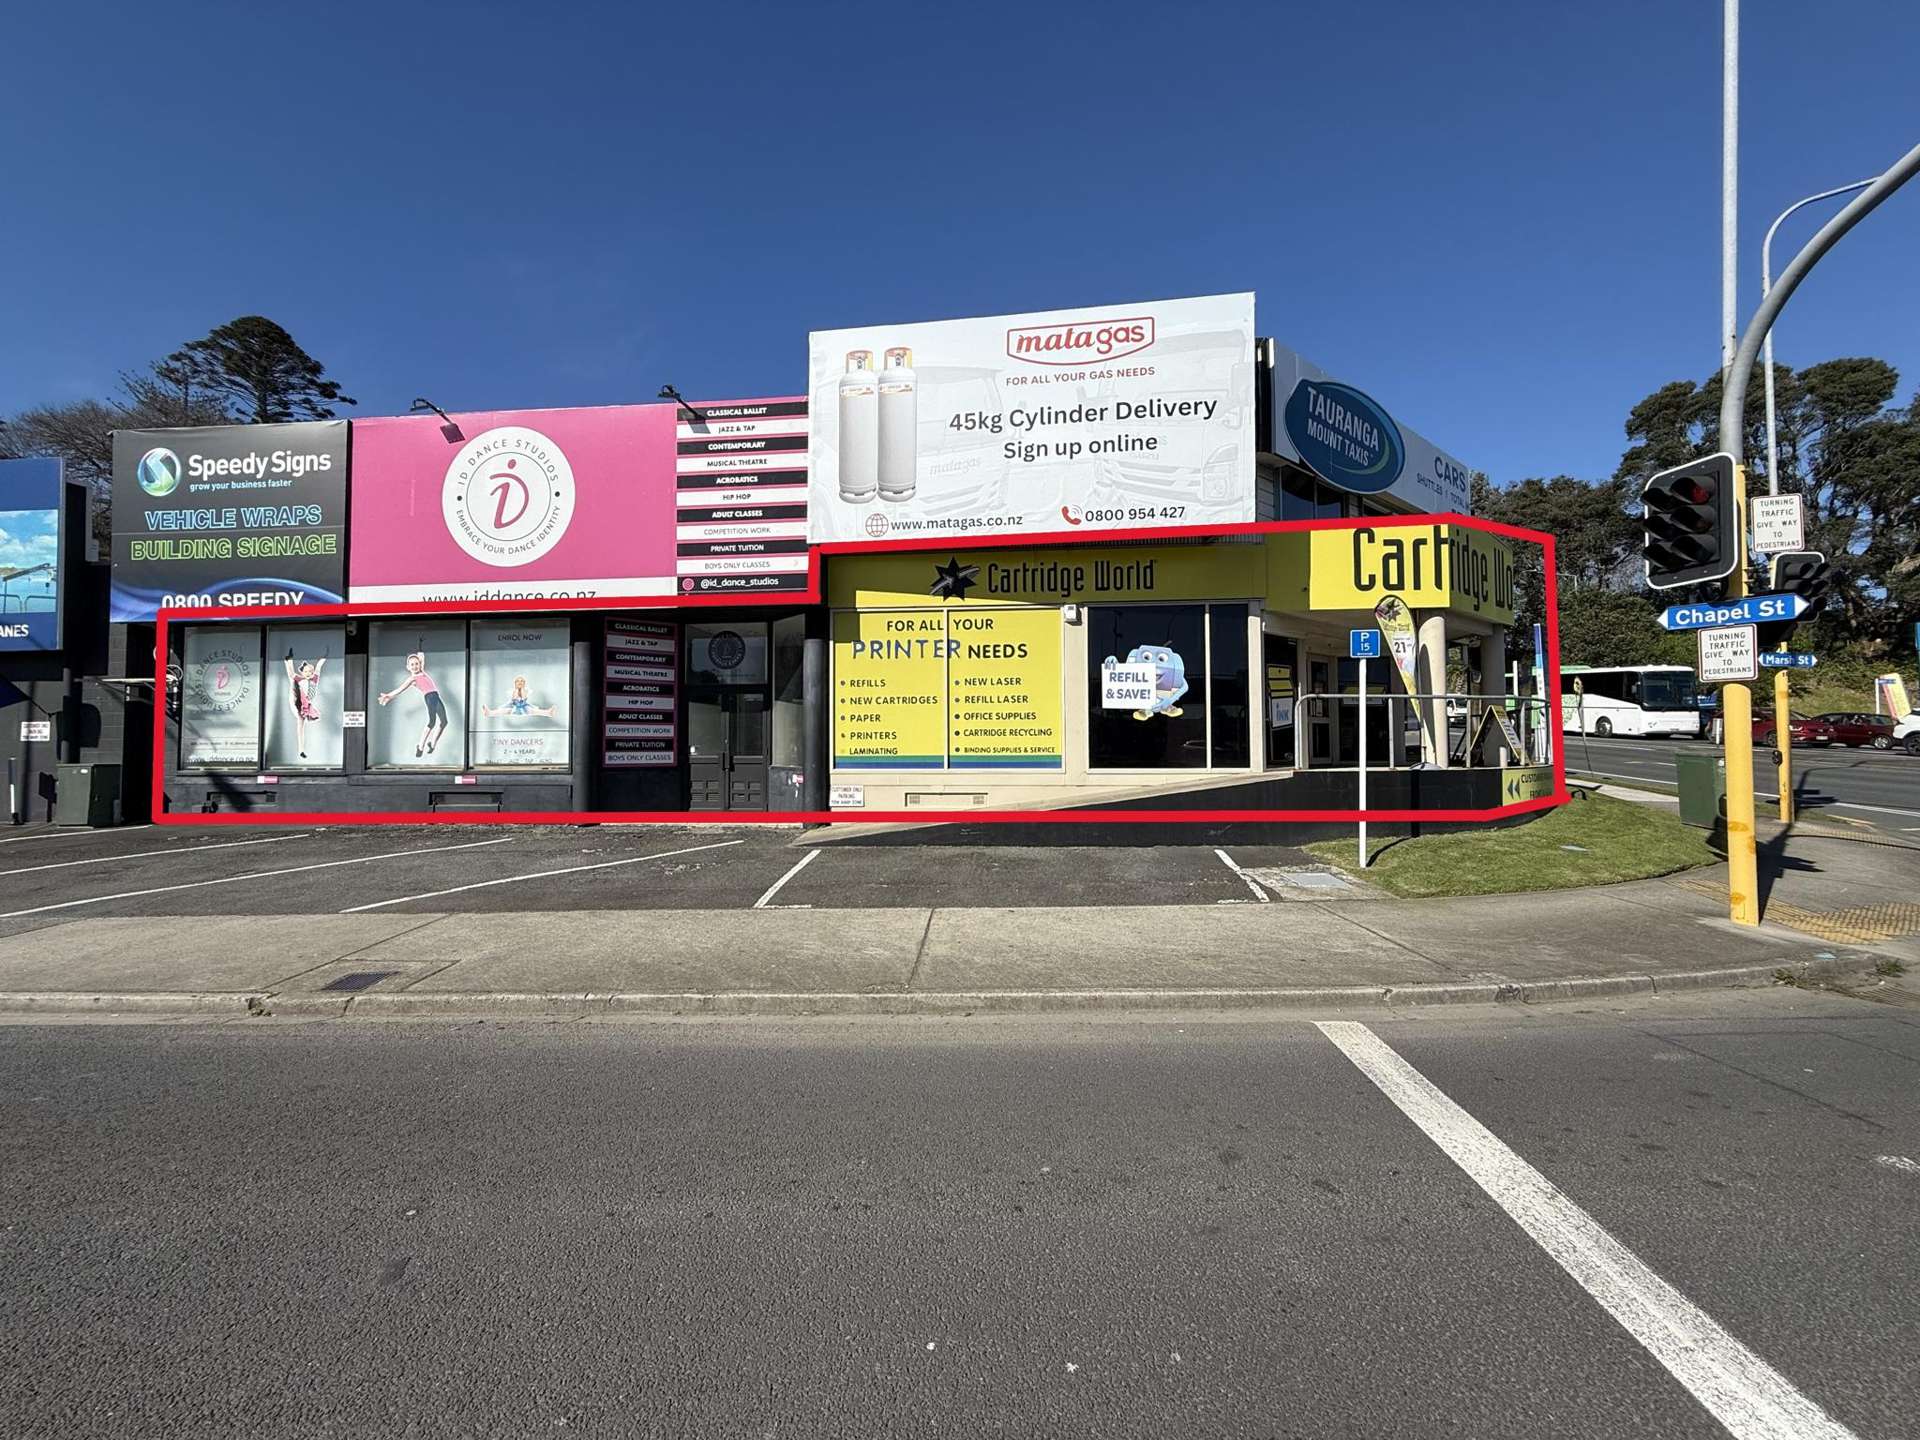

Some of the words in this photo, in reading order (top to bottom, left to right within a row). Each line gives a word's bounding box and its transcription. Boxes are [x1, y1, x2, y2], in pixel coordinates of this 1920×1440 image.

[1016, 323, 1145, 355] matagas
[1005, 376, 1026, 387] FOR
[1029, 375, 1051, 385] ALL
[1054, 373, 1086, 383] YOUR
[1089, 370, 1113, 381] GAS
[1116, 367, 1156, 378] NEEDS
[707, 409, 741, 417] CLASSICAL
[743, 407, 767, 415] BALLET
[949, 411, 1003, 434] 45kg
[1009, 403, 1108, 432] Cylinder
[1116, 397, 1218, 421] Delivery
[1307, 387, 1379, 451] TAURANGA
[718, 425, 735, 434] JAZZ
[708, 442, 765, 450] CONTEMPORARY
[1307, 418, 1343, 450] MOUNT
[1344, 438, 1369, 467] TAXIS
[1003, 441, 1049, 465] Sign
[1055, 442, 1082, 461] up
[1089, 434, 1158, 456] online
[188, 452, 268, 479] Speedy
[272, 449, 332, 476] Signs
[458, 471, 468, 485] ID
[468, 439, 507, 466] DANCE
[515, 439, 559, 481] STUDIOS
[1434, 456, 1466, 492] CARS
[716, 476, 758, 484] ACROBATICS
[190, 484, 210, 492] grow
[212, 483, 229, 491] your
[230, 481, 267, 489] business
[268, 479, 292, 488] faster
[1760, 498, 1794, 507] TURNING
[145, 508, 236, 530] VEHICLE
[241, 504, 322, 527] WRAPS
[1085, 509, 1124, 523] 0800
[1128, 507, 1156, 521] 954
[1160, 506, 1185, 519] 427
[1761, 508, 1794, 517] TRAFFIC
[890, 514, 1024, 532] www.matagas.co.nz
[1756, 520, 1773, 529] GIVE
[1781, 519, 1798, 527] WAY
[456, 510, 481, 545] EMBRACE
[483, 542, 505, 554] YOUR
[508, 541, 536, 554] DANCE
[538, 506, 561, 542] IDENTITY
[131, 537, 232, 561] BUILDING
[237, 534, 337, 557] SIGNAGE
[1756, 540, 1801, 549] PEDESTRIANS
[1353, 525, 1489, 612] Cartridge
[988, 562, 1084, 597] Cartridge
[1094, 559, 1155, 592] World
[700, 578, 779, 589] @id_dance_studios
[1675, 602, 1751, 626] Chapel
[1758, 600, 1786, 617] St
[887, 620, 914, 632] FOR
[919, 619, 944, 631] ALL
[953, 619, 994, 631] YOUR
[523, 633, 543, 641] NOW
[1360, 632, 1370, 642] P
[1708, 632, 1746, 641] TURNING
[852, 639, 961, 661] PRINTER
[968, 644, 1028, 659] NEEDS
[1360, 642, 1370, 651] 15
[1394, 641, 1406, 653] 21
[1709, 641, 1745, 650] TRAFFIC
[615, 653, 666, 663] CONTEMPORARY
[1704, 651, 1723, 659] GIVE
[1732, 649, 1750, 657] WAY
[1766, 655, 1795, 665] Marsh
[1798, 655, 1809, 664] St
[614, 669, 642, 677] MUSICAL
[1704, 666, 1752, 675] PEDESTRIANS
[964, 677, 987, 686] NEW
[990, 677, 1022, 686] LASER
[1109, 671, 1149, 682] REFILL
[850, 679, 886, 687] REFILLS
[623, 684, 660, 693] ACROBATICS
[964, 695, 994, 704] REFILL
[997, 695, 1028, 703] LASER
[1106, 689, 1115, 700] &
[1117, 689, 1150, 700] SAVE!
[850, 696, 873, 705] NEW
[875, 695, 938, 705] CARTRIDGES
[639, 713, 663, 721] CLASSES
[850, 713, 881, 723] PAPER
[964, 712, 992, 721] OFFICE
[995, 712, 1036, 720] SUPPLIES
[608, 727, 651, 735] COMPETITION
[652, 727, 671, 735] WORK
[850, 731, 897, 740] PRINTERS
[964, 728, 1007, 737] CARTRIDGE
[1009, 728, 1052, 737] RECYCLING
[849, 747, 898, 755] LAMINATING
[608, 754, 623, 762] BOYS
